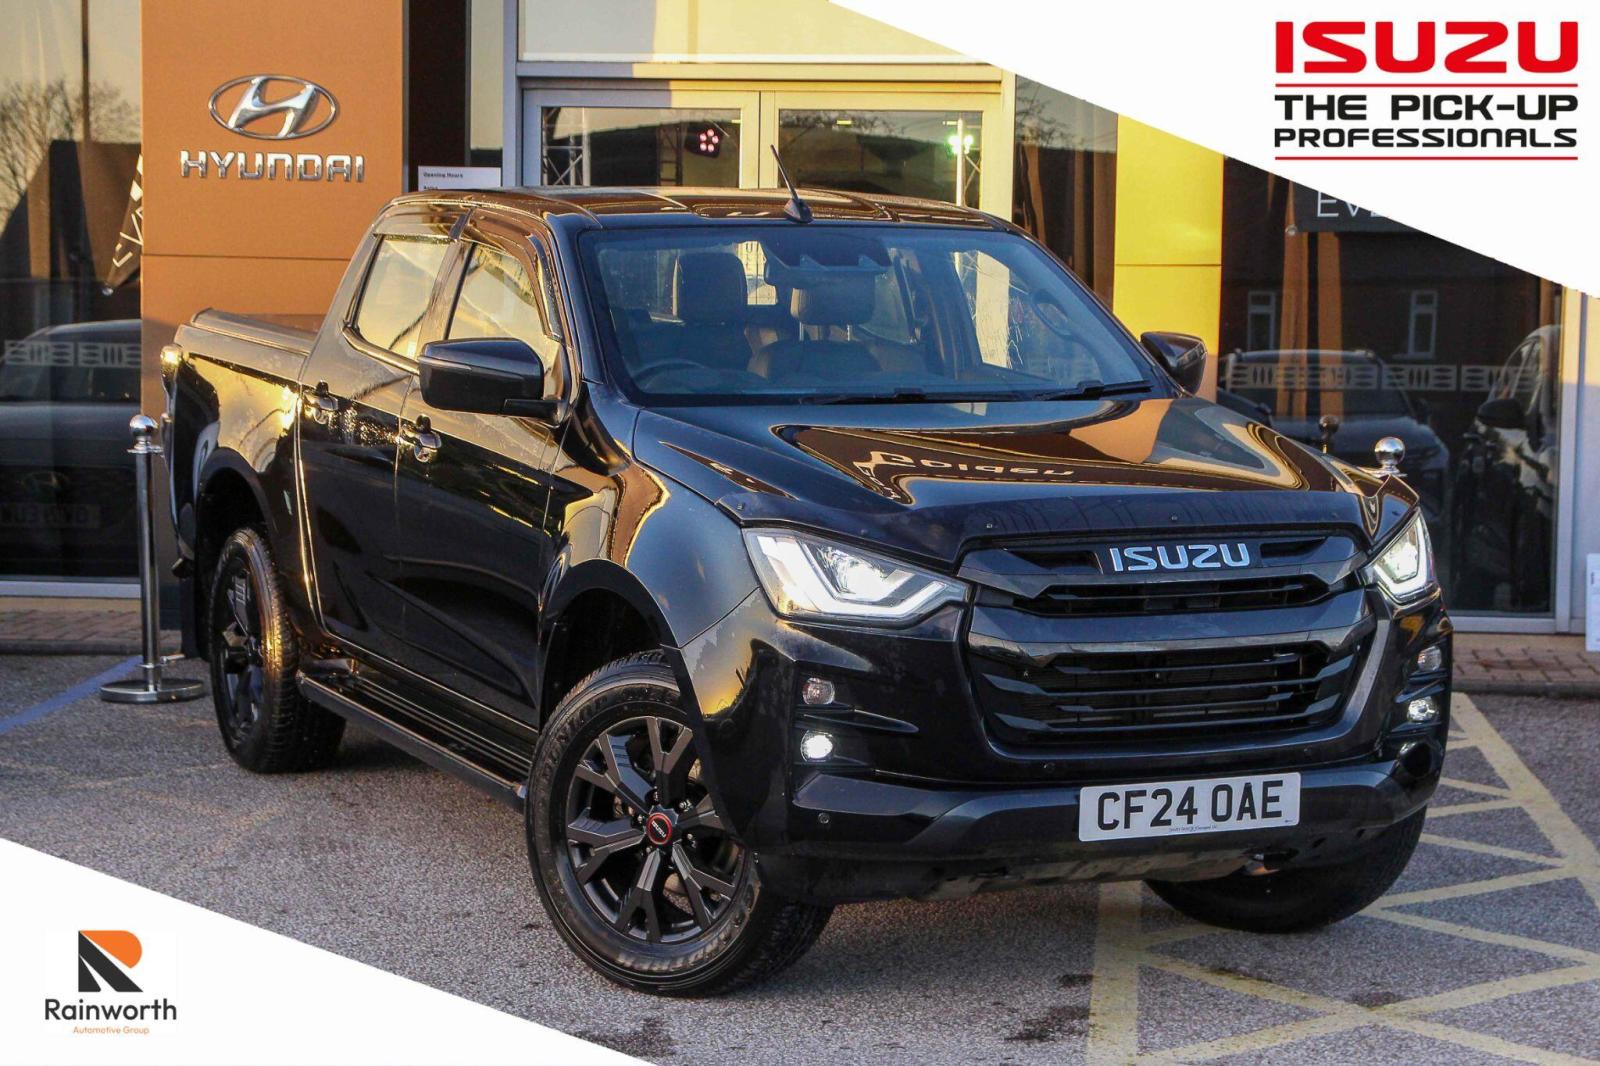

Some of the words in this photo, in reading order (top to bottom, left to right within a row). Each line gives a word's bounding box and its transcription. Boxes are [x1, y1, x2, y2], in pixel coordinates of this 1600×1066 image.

[180, 150, 365, 183] HYUNDAI
[1109, 543, 1251, 572] ISUZU
[1097, 786, 1198, 831] CF24
[1211, 779, 1284, 823] OAE
